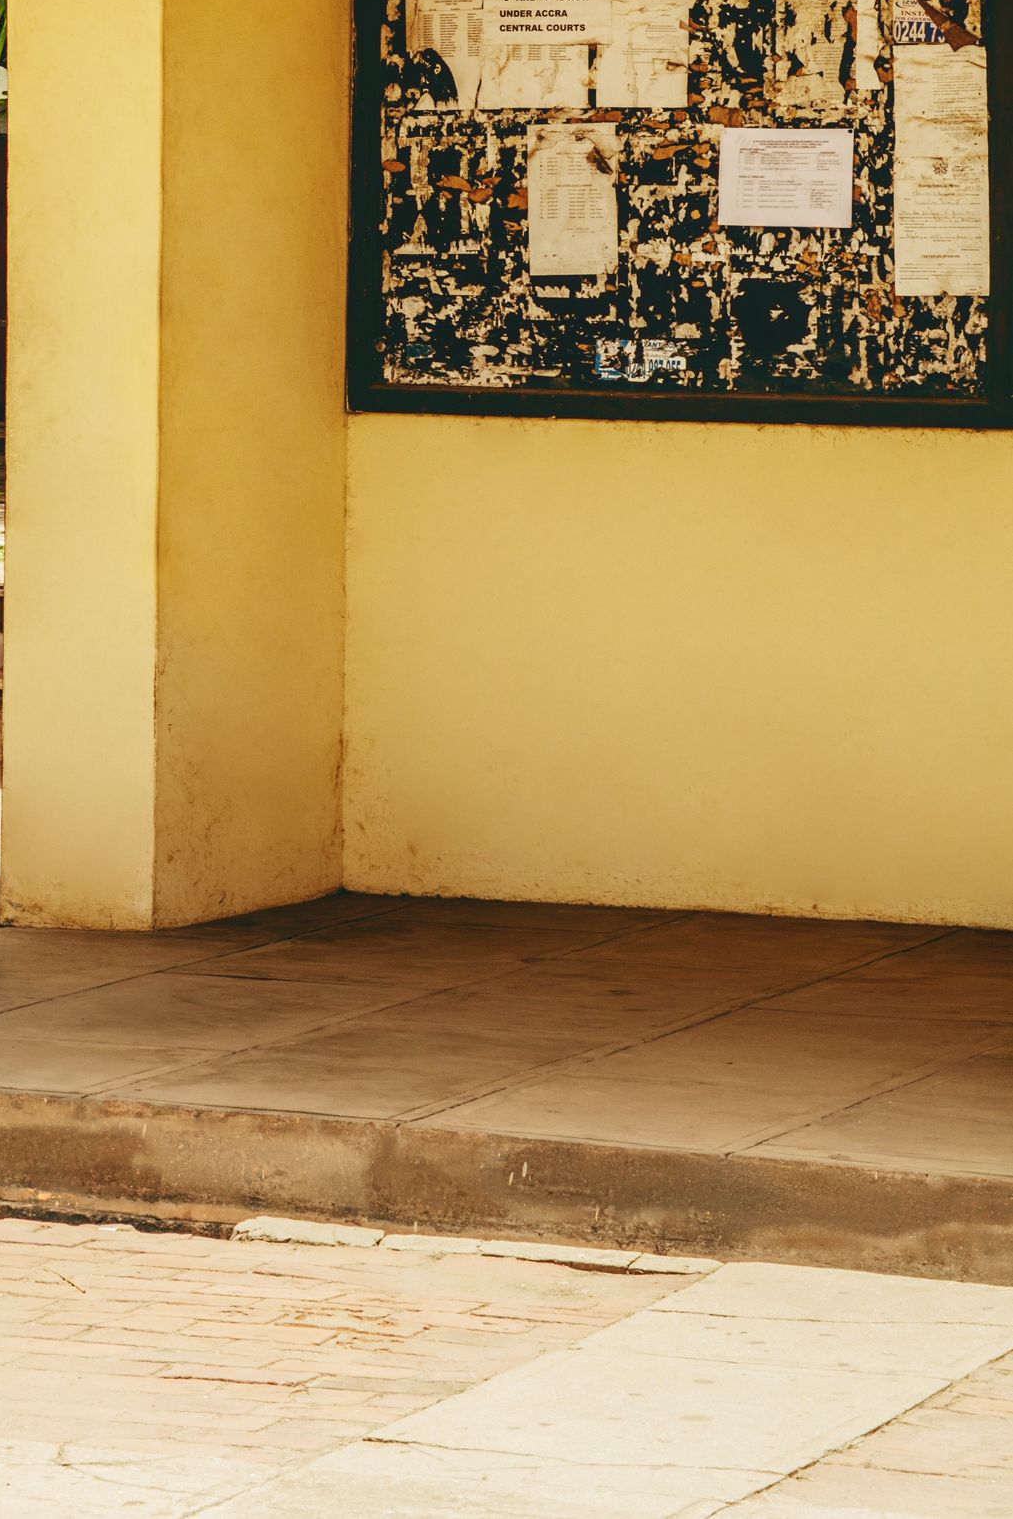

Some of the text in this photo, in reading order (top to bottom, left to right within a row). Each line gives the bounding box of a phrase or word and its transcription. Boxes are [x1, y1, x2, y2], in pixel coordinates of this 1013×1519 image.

[499, 9, 568, 18] UNDER ACCRA
[499, 24, 586, 32] CENTRAL COURTS
[894, 21, 926, 43] 0244
